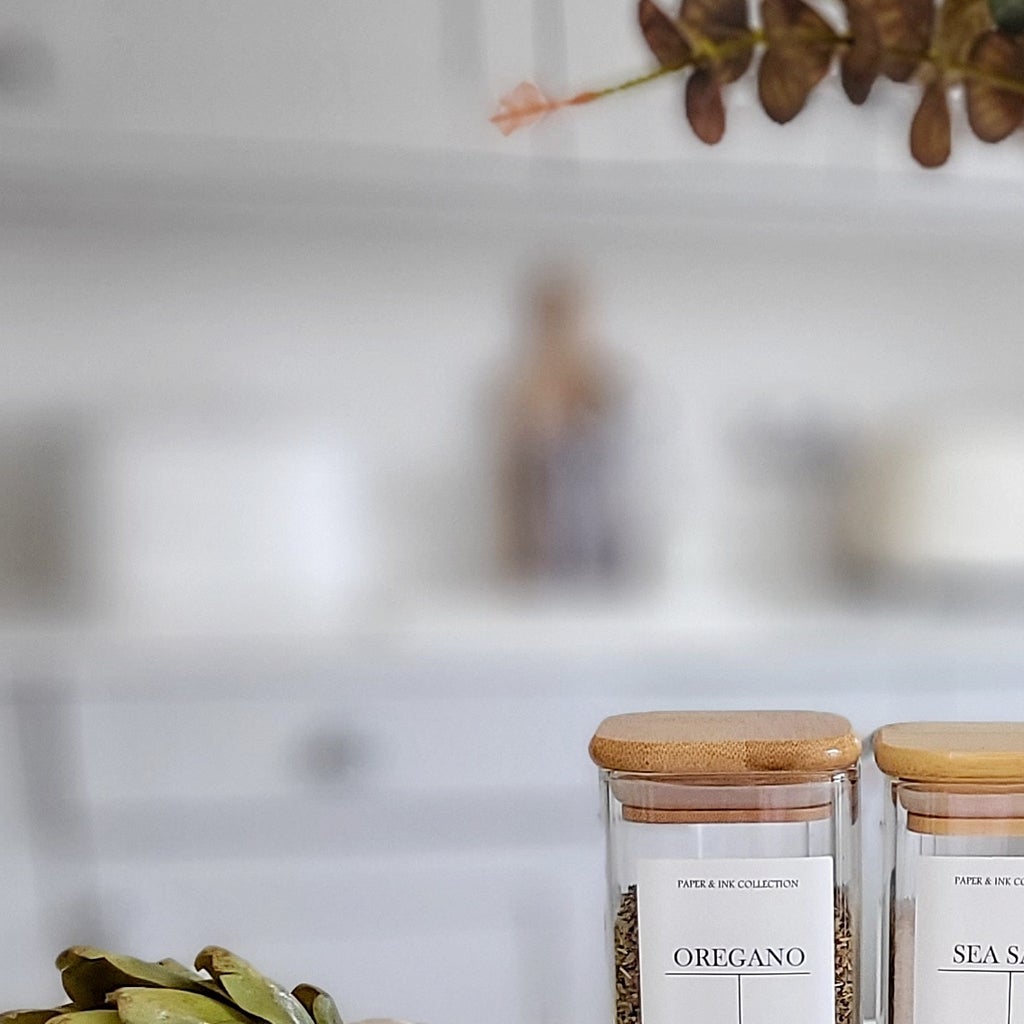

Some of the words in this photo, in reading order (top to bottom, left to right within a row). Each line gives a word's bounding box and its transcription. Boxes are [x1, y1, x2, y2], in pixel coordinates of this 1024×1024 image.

[677, 879, 707, 889] PAPER
[707, 879, 716, 889] &
[717, 879, 736, 889] INK
[737, 879, 800, 889] COLLECTION
[953, 876, 984, 886] PAPER
[984, 876, 992, 886] &
[994, 876, 1012, 887] INK
[674, 948, 805, 967] OREGANO
[953, 945, 999, 964] SEA
